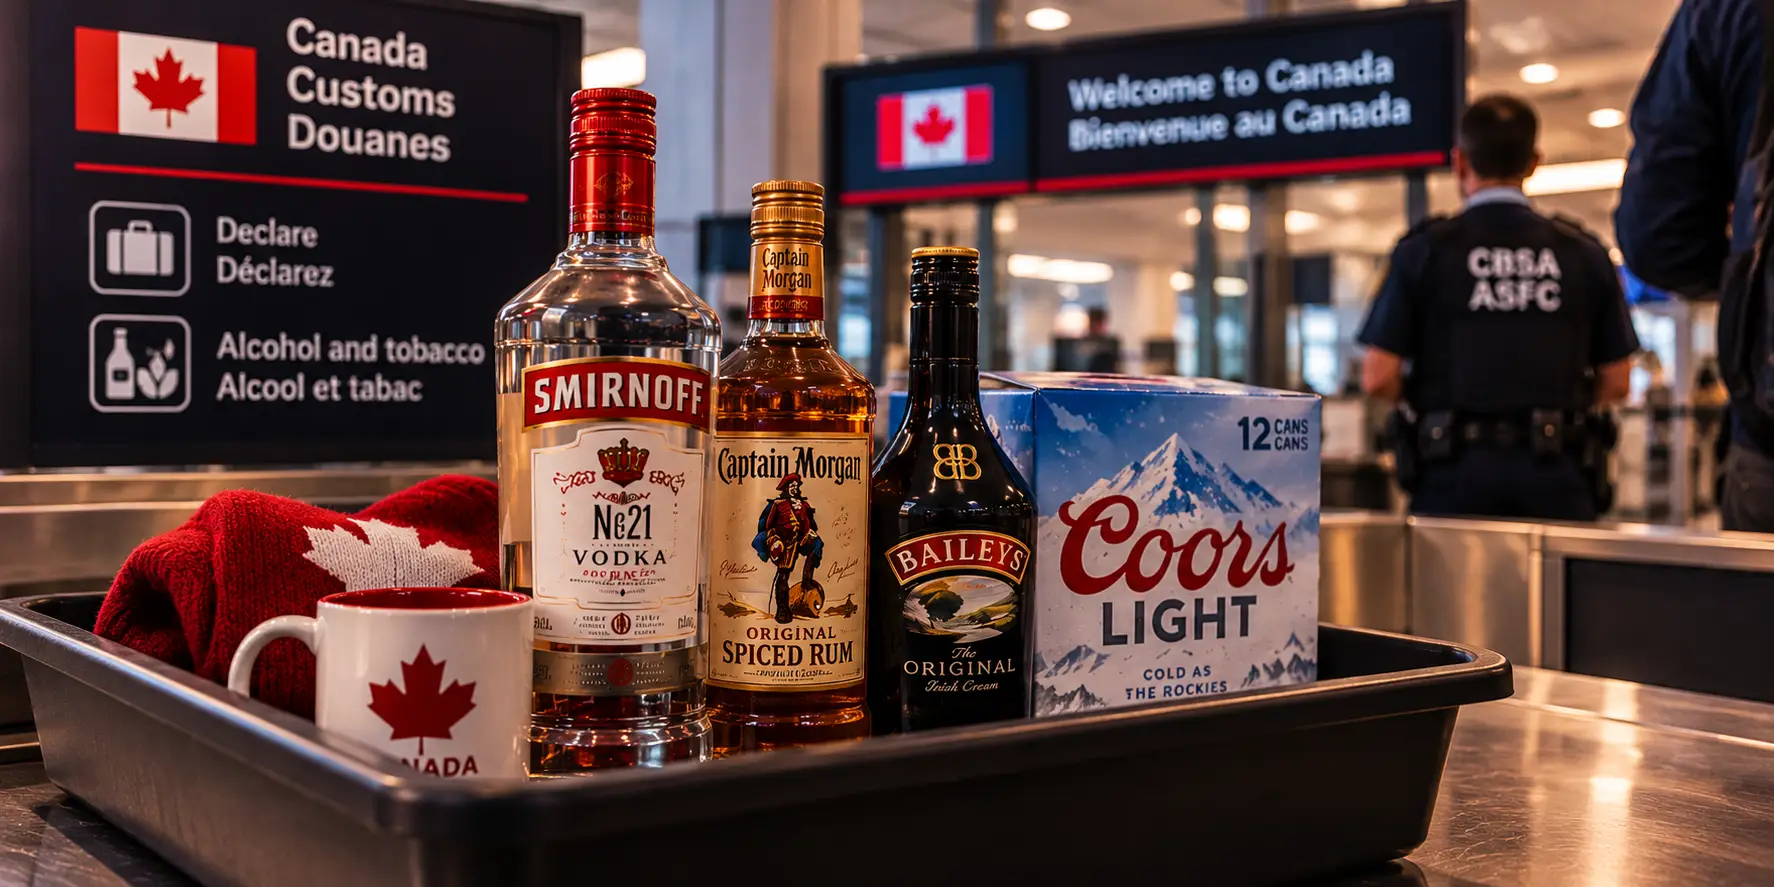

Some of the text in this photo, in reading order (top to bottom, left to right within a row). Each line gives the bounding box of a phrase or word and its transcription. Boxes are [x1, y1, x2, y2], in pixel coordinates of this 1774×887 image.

[286, 17, 428, 71] Canada
[286, 65, 456, 118] Customs
[1068, 49, 1395, 112] Welcome to Canada
[1068, 90, 1412, 152] Bienvenue au Canada
[287, 113, 451, 163] Douanes
[216, 215, 319, 248] Declare
[216, 255, 335, 287] Déclarez
[762, 247, 809, 270] Captain
[1467, 246, 1562, 280] CBSA
[761, 269, 812, 293] Morgan
[1467, 279, 1562, 312] ASFC
[216, 331, 486, 364] Alcohol and tobacco
[216, 371, 423, 402] Alcool et tabac
[534, 371, 704, 415] SMIRNOFF
[1237, 416, 1309, 451] 12 CANS
[1274, 436, 1309, 451] CANS
[717, 446, 862, 486] Captain Morgan
[572, 549, 667, 566] VODKA
[896, 537, 1024, 575] BAILEYS
[1058, 494, 1296, 596] Coors
[746, 625, 837, 641] ORIGINAL
[1102, 594, 1258, 647] LIGHT
[722, 639, 854, 667] SPICED RUM
[903, 658, 1016, 677] ORIGINAL
[962, 679, 999, 693] Cream
[1143, 665, 1212, 681] COLD AS
[1125, 681, 1228, 700] THE ROCKIES
[401, 754, 479, 778] NADA
